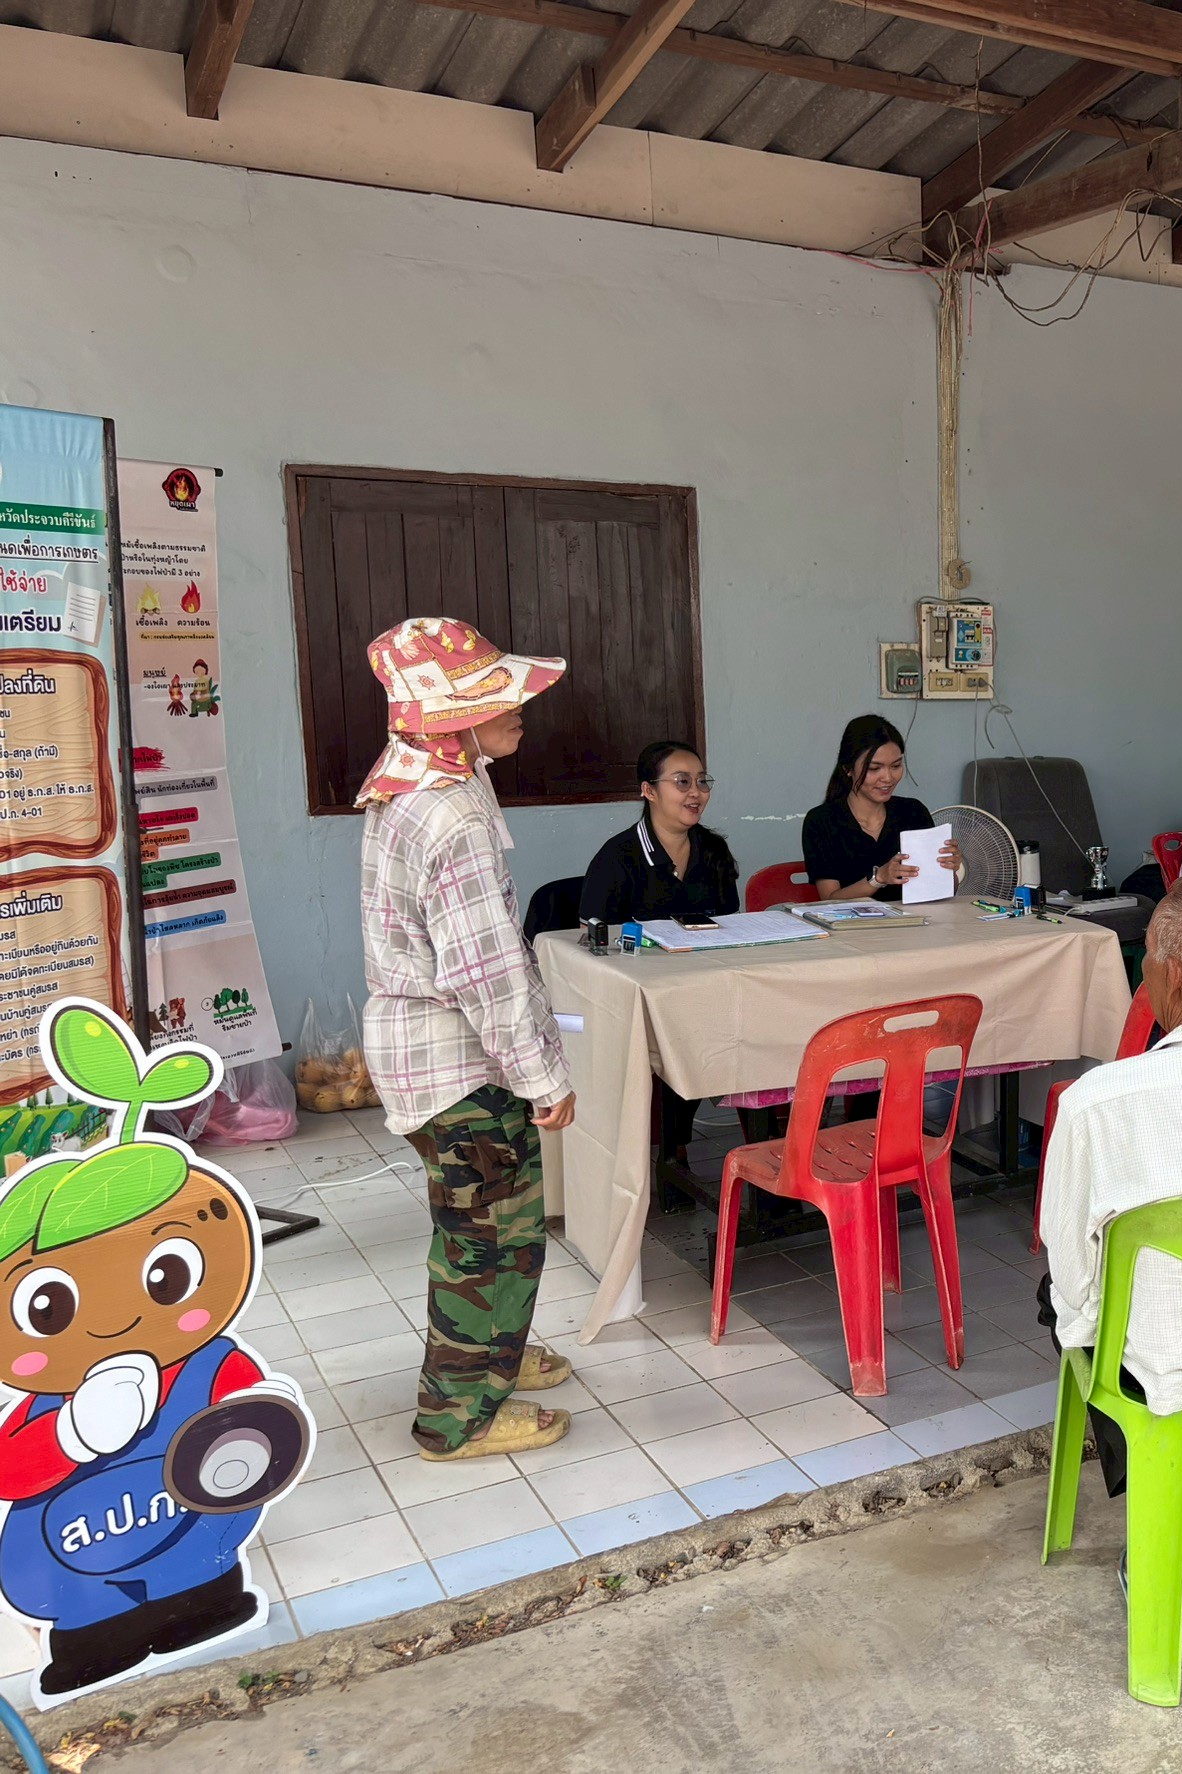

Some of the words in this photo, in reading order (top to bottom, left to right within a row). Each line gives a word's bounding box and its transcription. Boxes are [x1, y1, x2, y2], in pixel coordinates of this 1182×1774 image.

[14, 787, 25, 800] อยู่
[56, 783, 66, 794] ให้
[22, 807, 42, 816] 4-01
